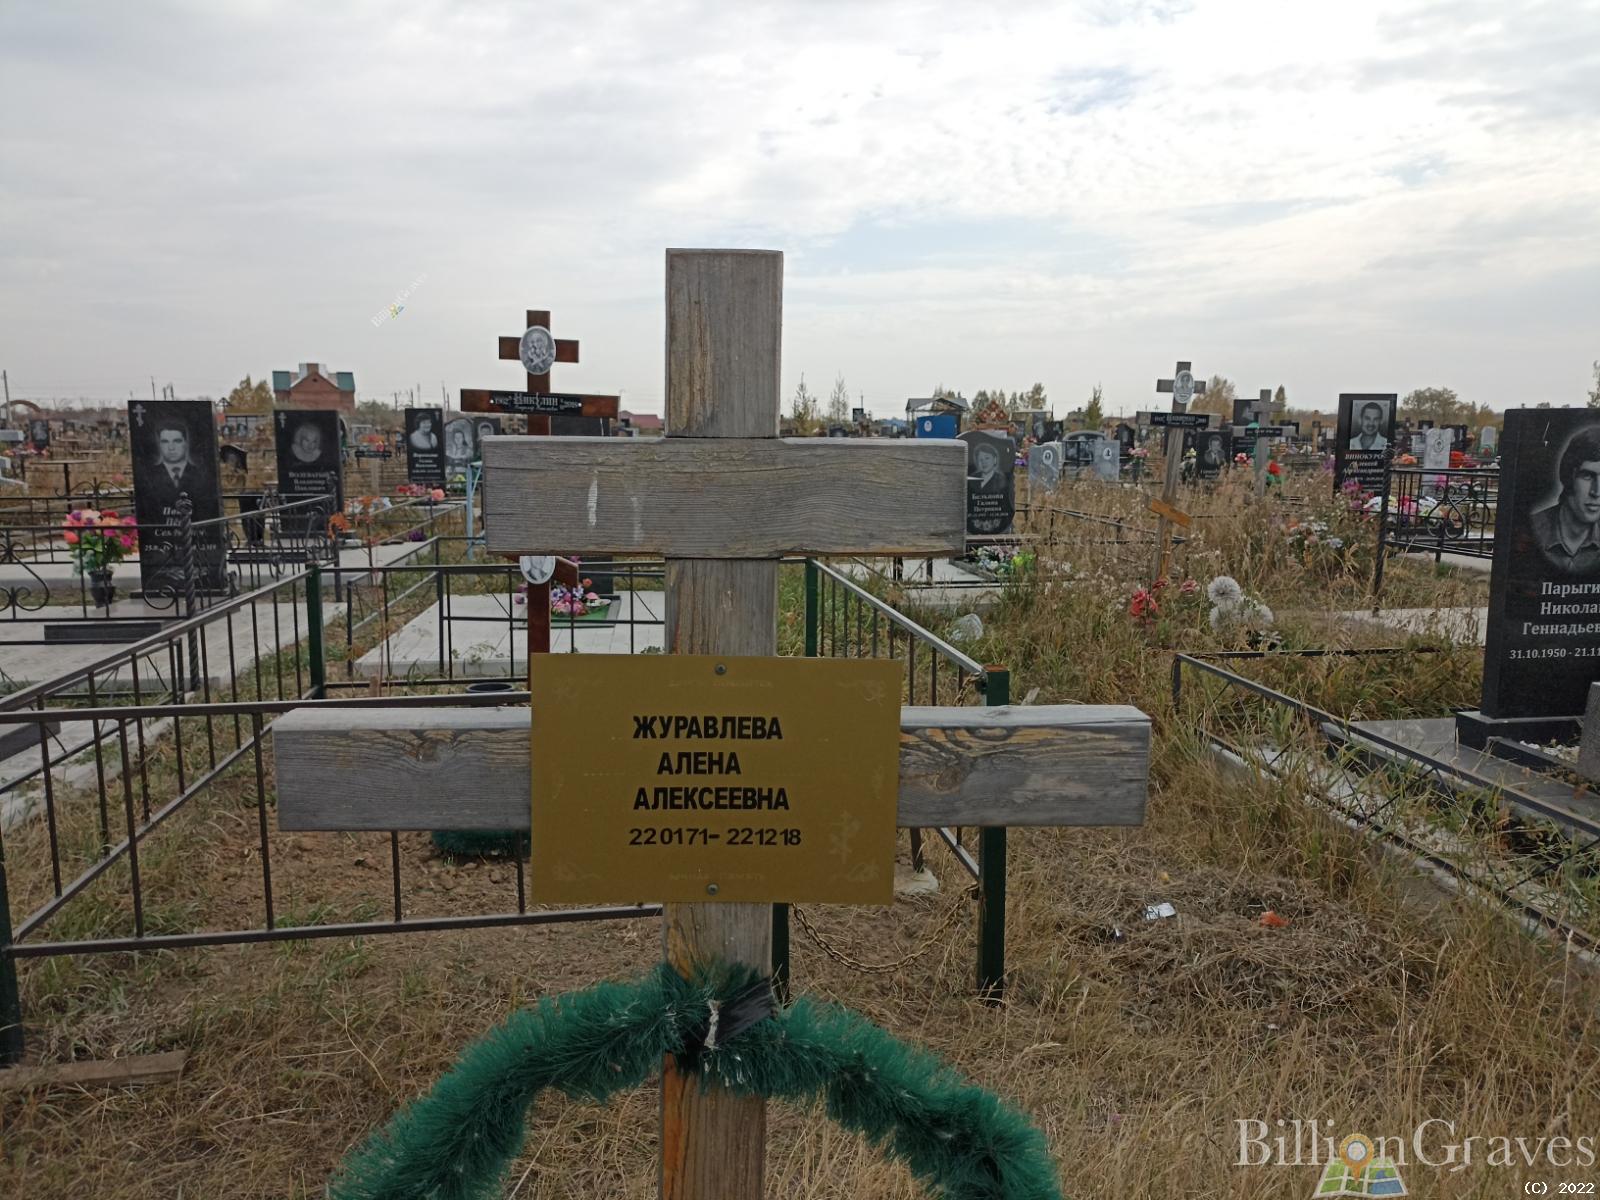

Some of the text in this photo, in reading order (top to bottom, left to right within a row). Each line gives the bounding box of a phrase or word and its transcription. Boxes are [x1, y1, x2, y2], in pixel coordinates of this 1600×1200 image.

[1509, 649, 1566, 659] 31.10.1950
[633, 716, 783, 740] ЖУРАВЛЕВА
[657, 752, 742, 775] АЛЕНА
[633, 787, 790, 810] АЛЕКСЕЕВНА
